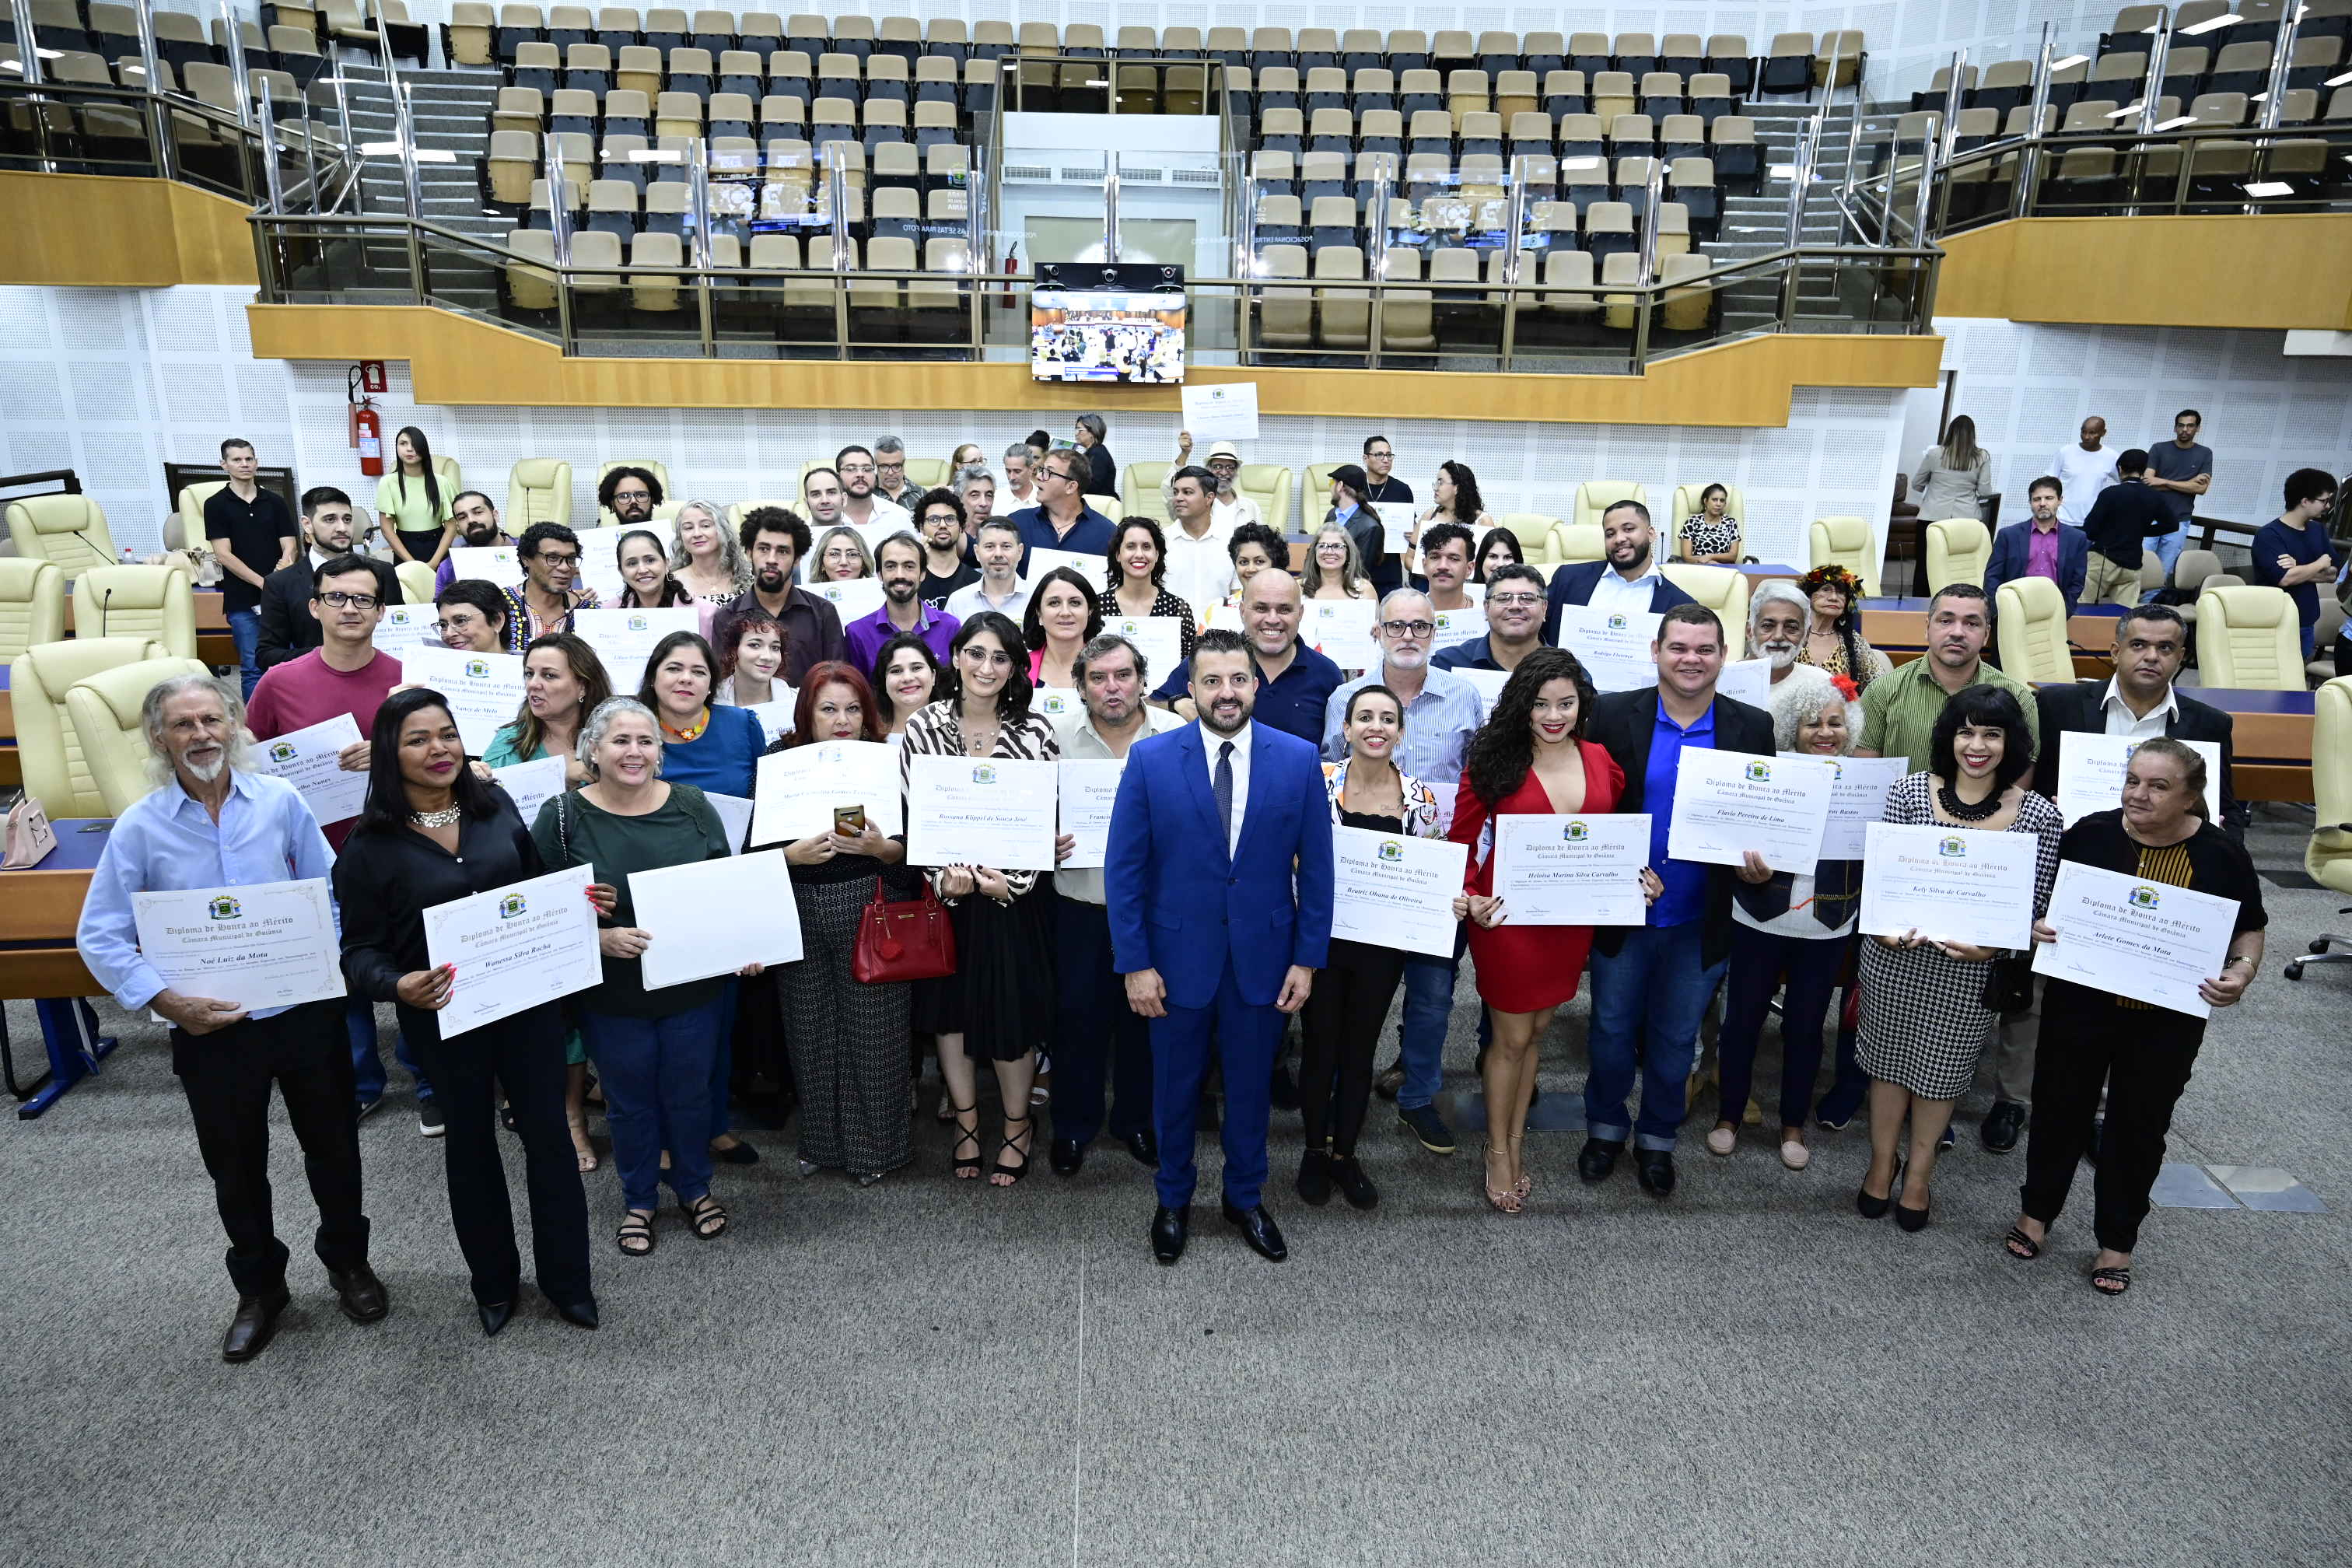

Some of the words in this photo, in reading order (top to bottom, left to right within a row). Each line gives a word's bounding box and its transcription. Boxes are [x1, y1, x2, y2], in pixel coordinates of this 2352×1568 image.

[1706, 778, 1737, 790] Diploma
[1737, 811, 1758, 820] Pereira
[1526, 844, 1555, 853] Diploma
[1339, 856, 1369, 868] Diploma
[1346, 887, 1367, 895] Beatriz
[1369, 889, 1389, 899] Ohana
[1398, 894, 1423, 905] Oliveira
[1913, 885, 1928, 894] Kely
[1956, 889, 1986, 898] Carvalho
[2081, 895, 2116, 912] Diploma
[2118, 905, 2128, 914] de
[2158, 916, 2168, 926] ao
[2171, 918, 2201, 933] Mérito
[166, 925, 202, 936] Diploma
[205, 924, 214, 933] de
[249, 920, 260, 929] ao
[262, 915, 293, 927] Mérito
[460, 927, 494, 943] Diploma
[495, 924, 504, 933] de
[2092, 931, 2116, 942] Arlete
[2116, 936, 2140, 948] Gomes
[2142, 943, 2151, 951] da
[2154, 946, 2172, 957] Mota
[218, 954, 234, 964] Luiz
[236, 953, 247, 961] da
[248, 950, 268, 961] Mota
[485, 955, 513, 968] Wanessa
[514, 949, 530, 960] Silva
[531, 942, 551, 954] Rocha
